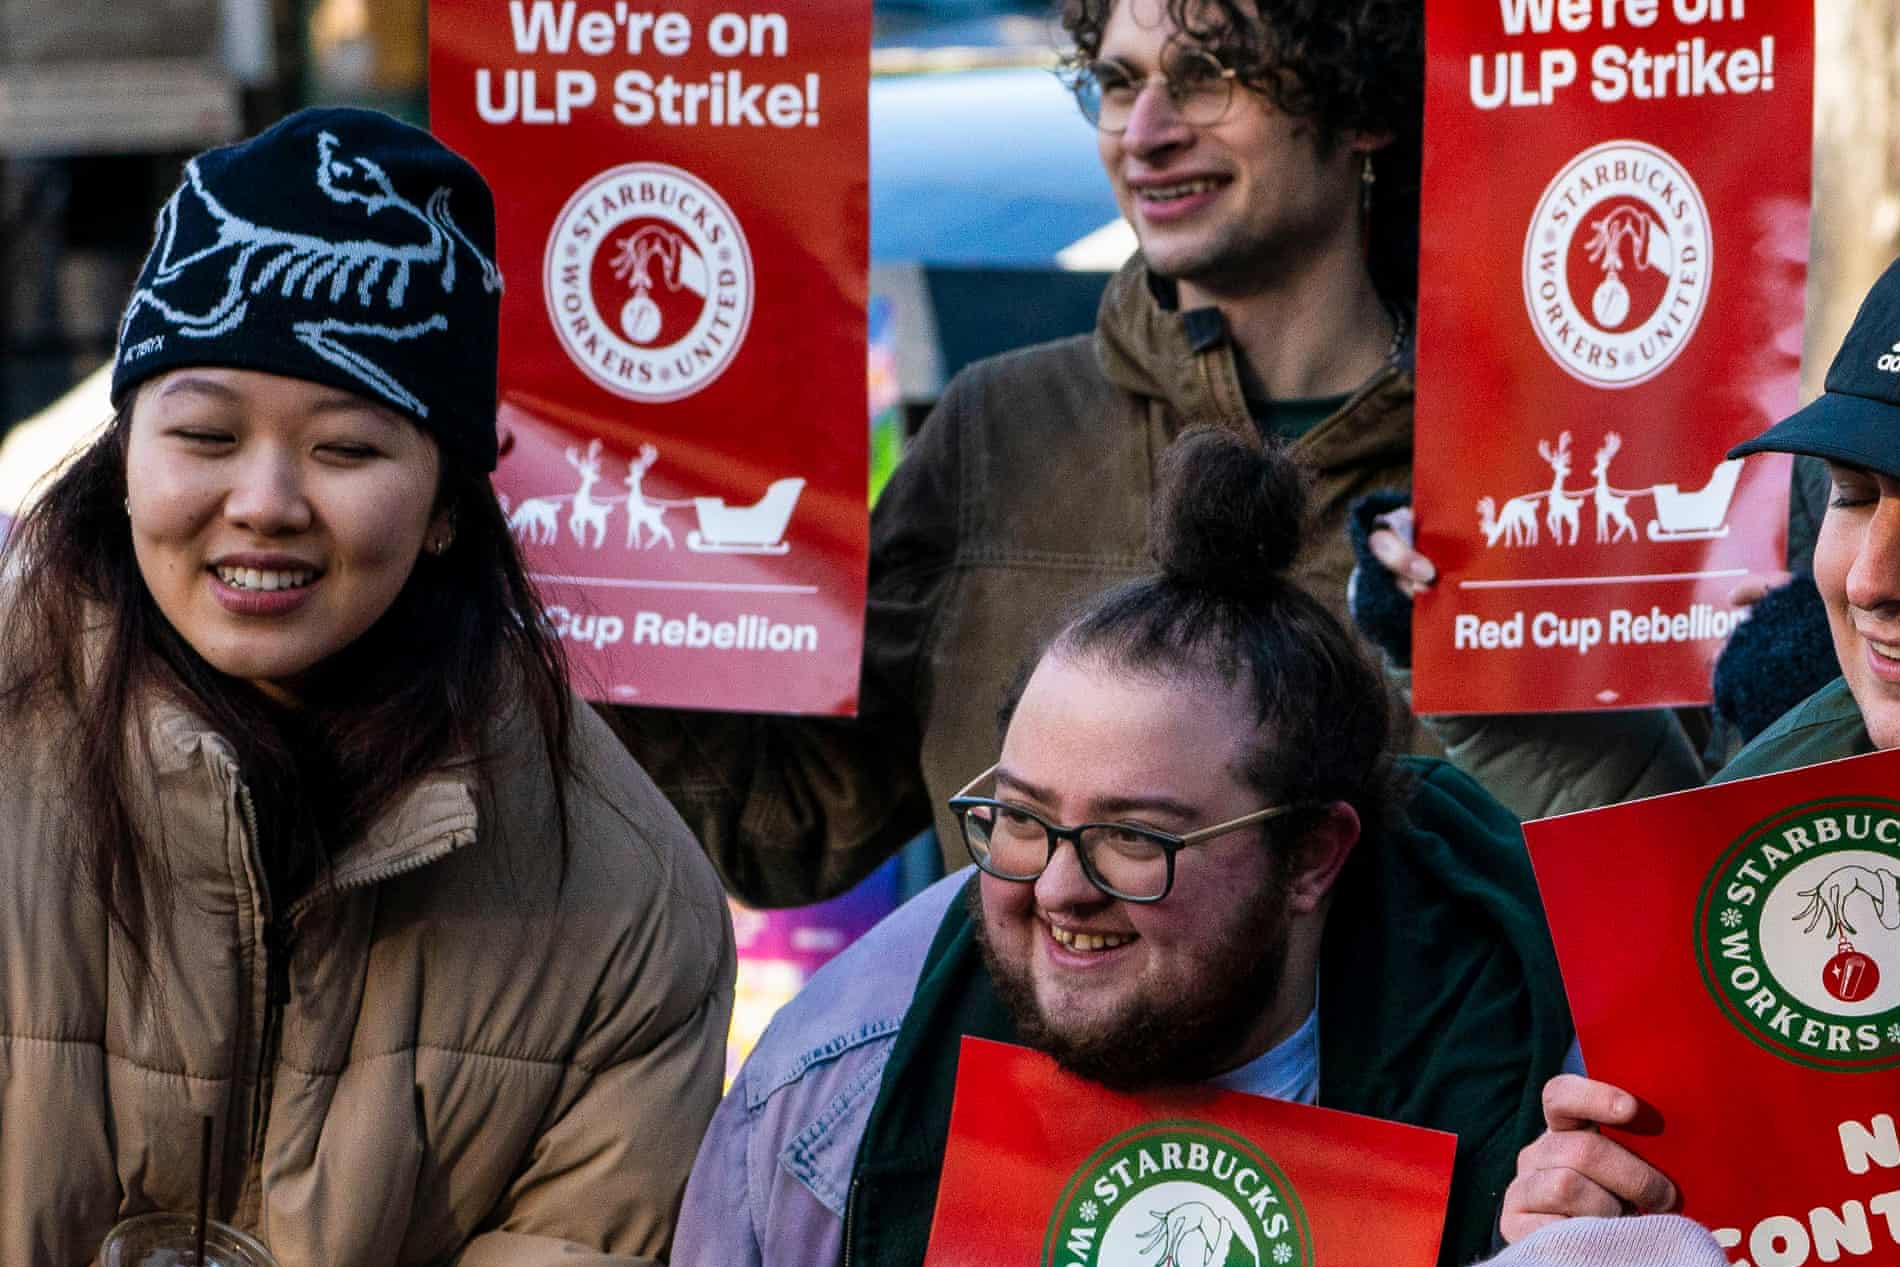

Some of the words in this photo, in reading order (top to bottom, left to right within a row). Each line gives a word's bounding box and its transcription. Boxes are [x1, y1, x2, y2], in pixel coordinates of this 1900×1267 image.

[508, 0, 692, 55] We're
[706, 10, 790, 57] on
[1500, 0, 1659, 35] Were
[475, 68, 597, 125] ULP
[613, 69, 821, 127] Strike!
[1470, 48, 1577, 110] ULP
[1591, 35, 1775, 102] Strike!
[572, 180, 724, 245] STARBUCKS
[1552, 158, 1690, 227] STARBUCKS
[561, 263, 654, 384] WORKERS
[675, 268, 738, 379] UNITED
[1540, 249, 1619, 369] WORKERS
[1637, 245, 1698, 362] UNITED
[632, 610, 819, 652] Rebellion
[1454, 611, 1524, 650] Red
[1532, 611, 1601, 654] Cup
[1720, 929, 1881, 1053] WORKERS
[1093, 1141, 1290, 1240] STARBUCKS
